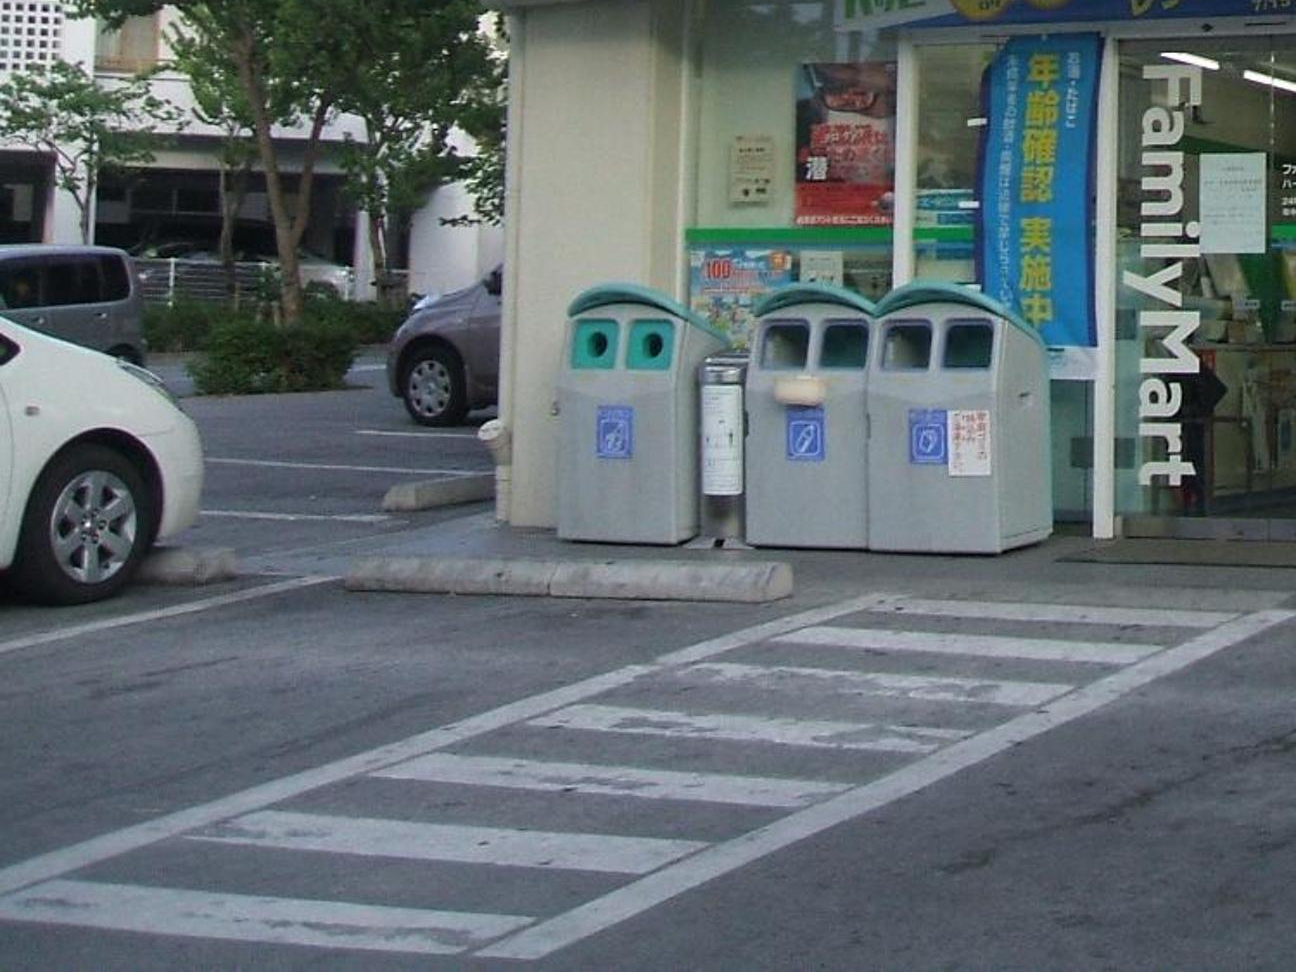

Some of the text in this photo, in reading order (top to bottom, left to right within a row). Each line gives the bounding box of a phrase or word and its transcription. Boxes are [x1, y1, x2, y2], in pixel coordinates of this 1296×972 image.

[1020, 216, 1055, 327] 実施中
[1123, 64, 1202, 487] FamilyMart
